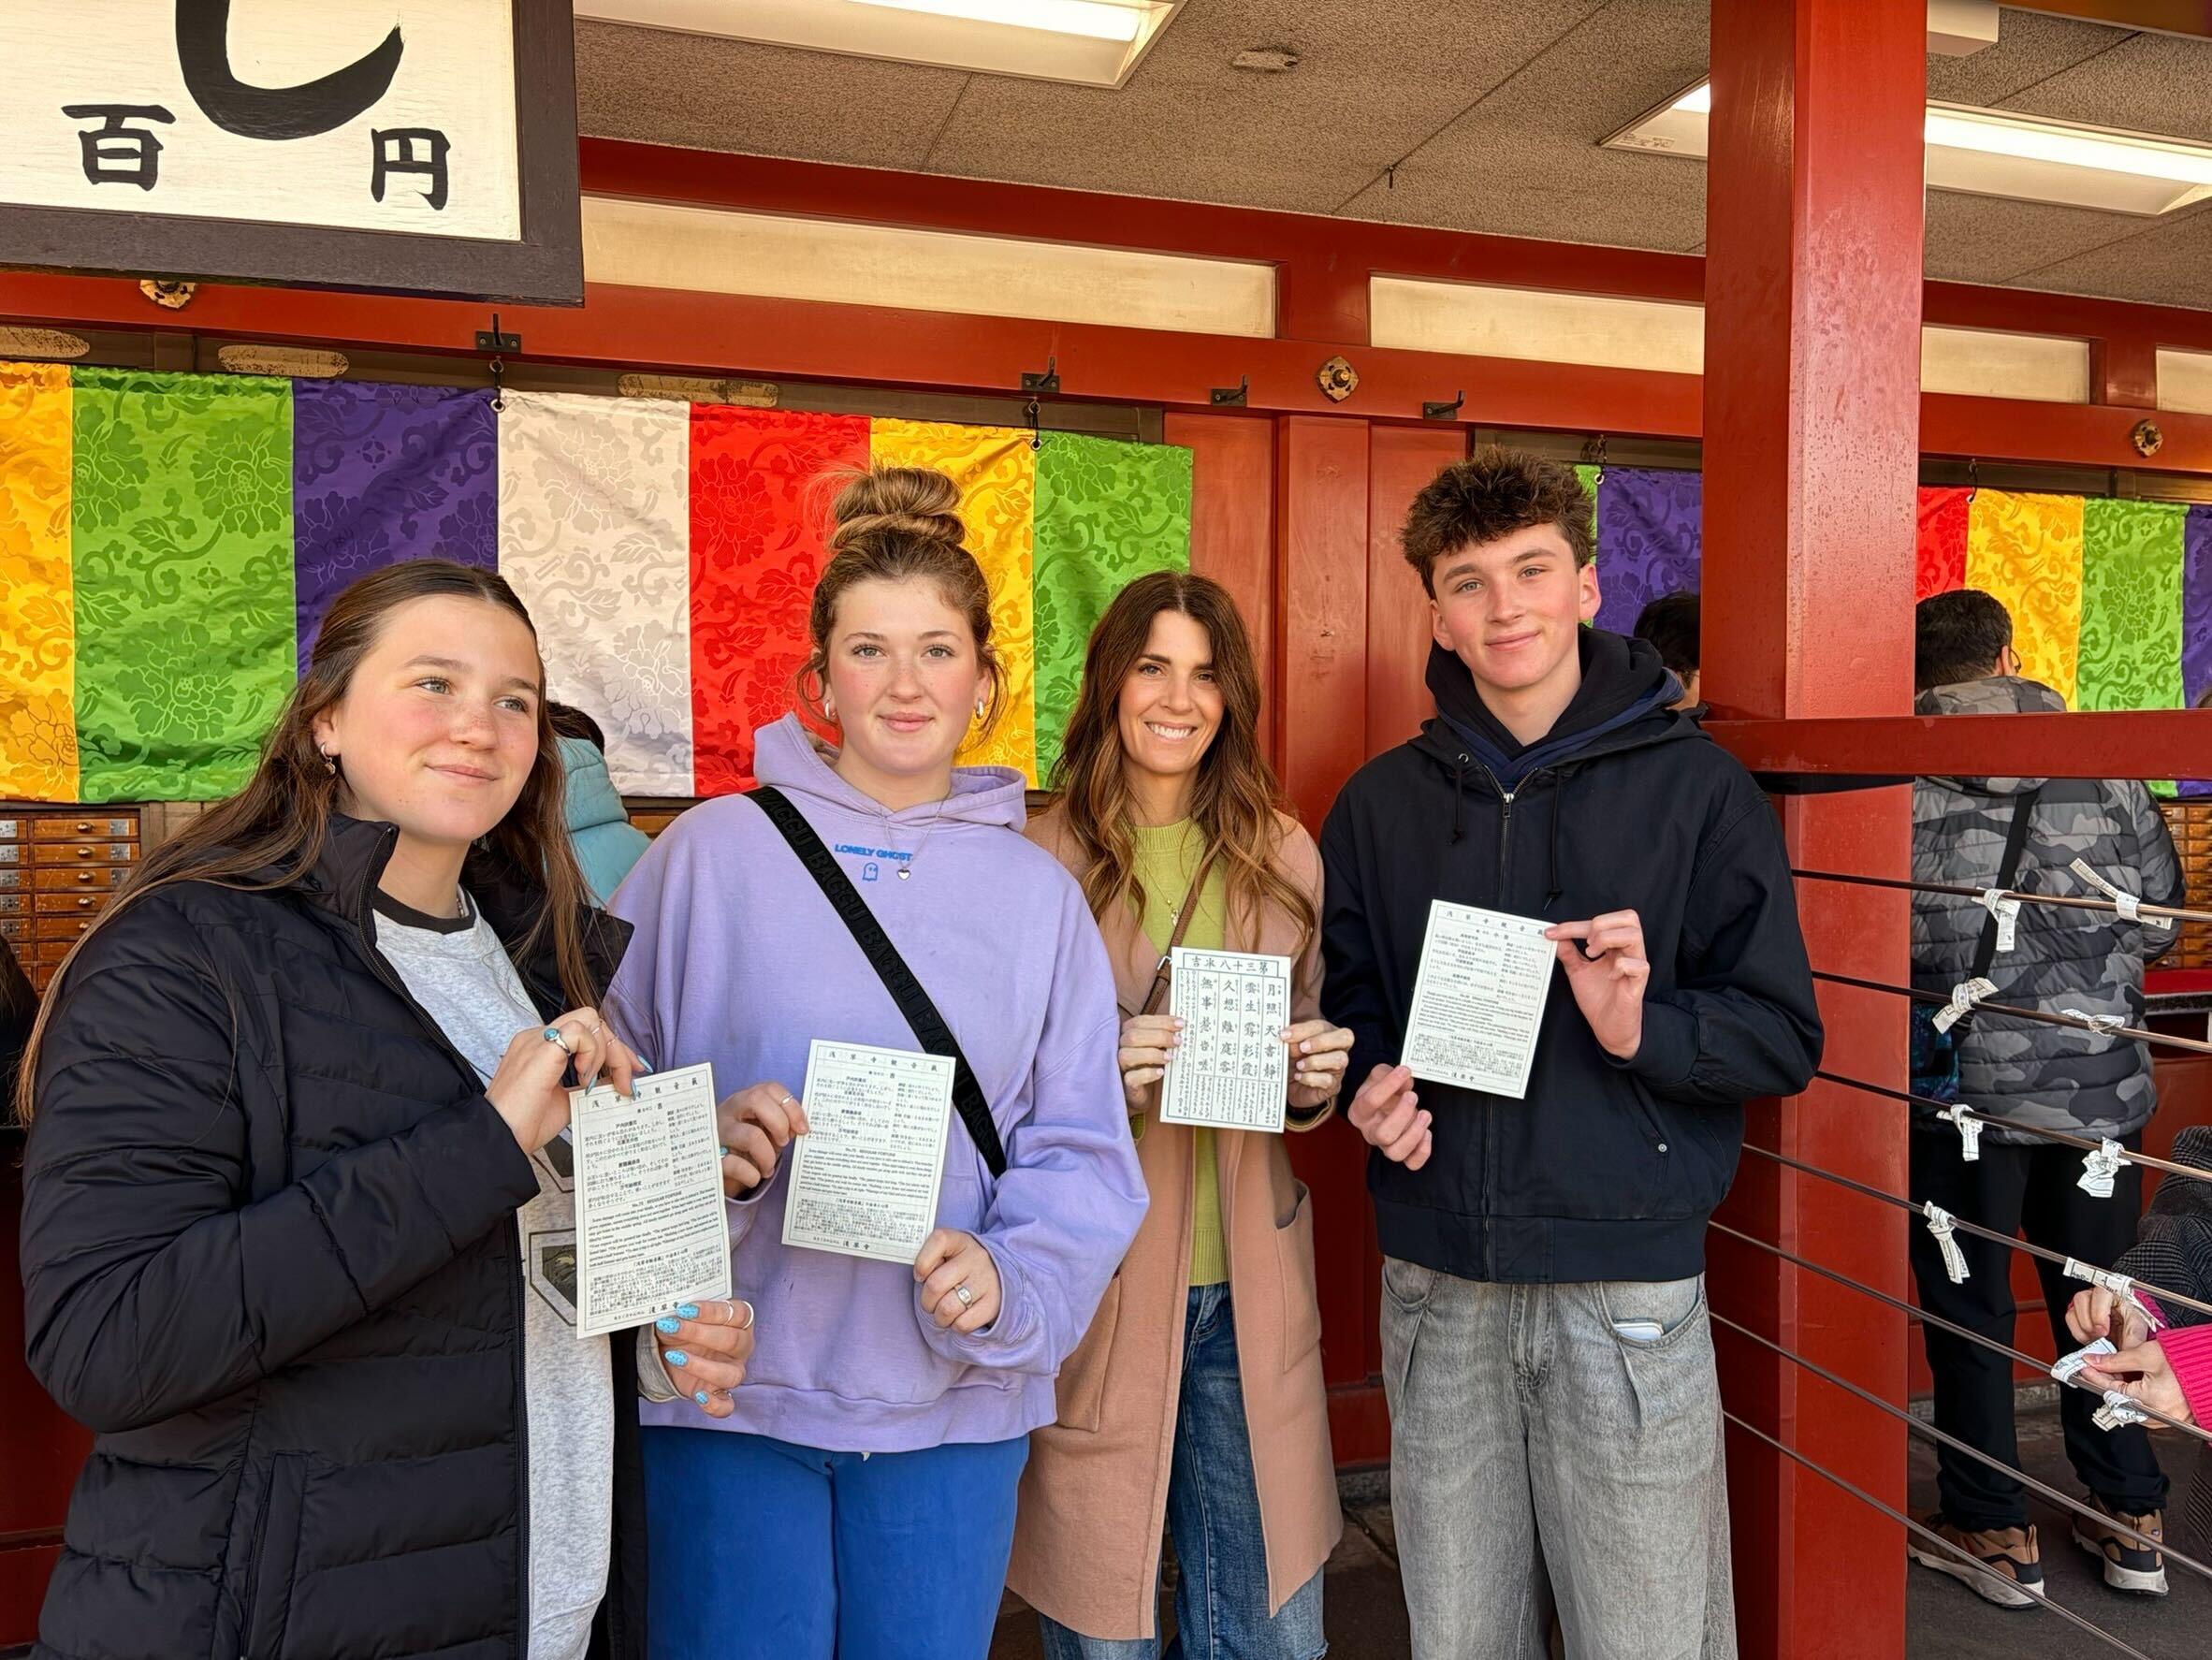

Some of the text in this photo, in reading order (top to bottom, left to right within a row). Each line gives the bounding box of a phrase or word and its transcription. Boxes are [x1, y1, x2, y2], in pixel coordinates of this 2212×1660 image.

[62, 104, 451, 211] 百 円
[835, 844, 913, 861] LONELY GHOST
